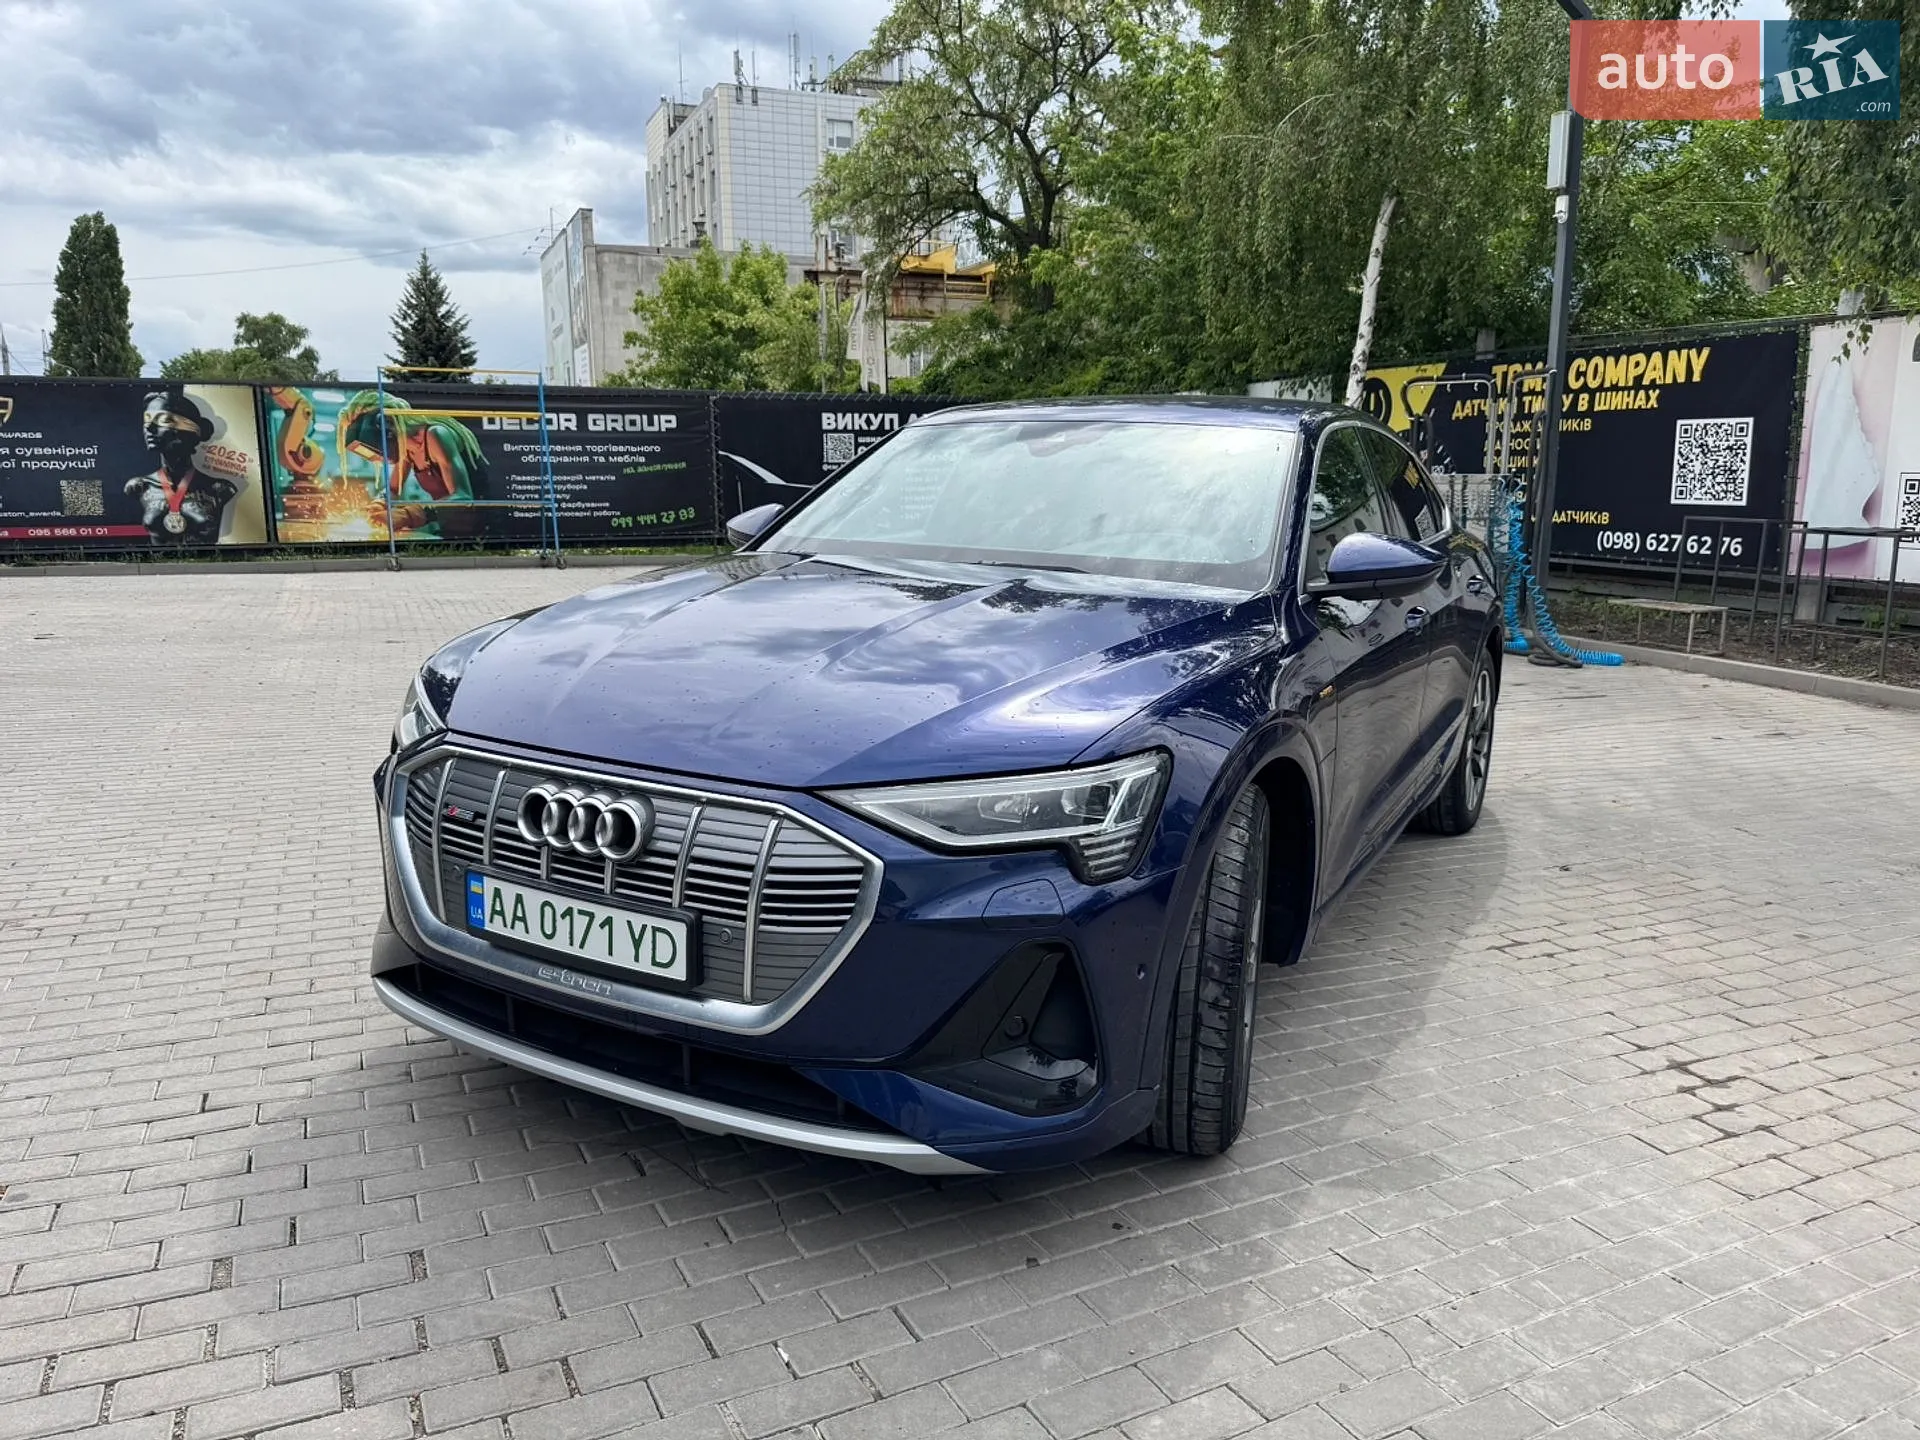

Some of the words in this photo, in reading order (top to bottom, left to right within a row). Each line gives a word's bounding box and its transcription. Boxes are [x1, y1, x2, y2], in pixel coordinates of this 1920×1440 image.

[1567, 346, 1711, 390] COMPANY
[1577, 393, 1590, 412] В
[1594, 390, 1660, 411] ШИНАХ
[587, 413, 678, 432] GROUP
[821, 412, 900, 431] ВИКУП
[15, 445, 98, 457] сувенірної
[206, 445, 248, 464] 2025
[21, 458, 96, 470] продукції
[1597, 530, 1641, 553] (098)
[1646, 533, 1683, 552] 627
[1686, 535, 1712, 555] 62
[1720, 536, 1743, 557] 76
[470, 906, 484, 920] UA
[489, 886, 530, 935] AA
[540, 899, 614, 958] 0171
[626, 919, 678, 969] YD
